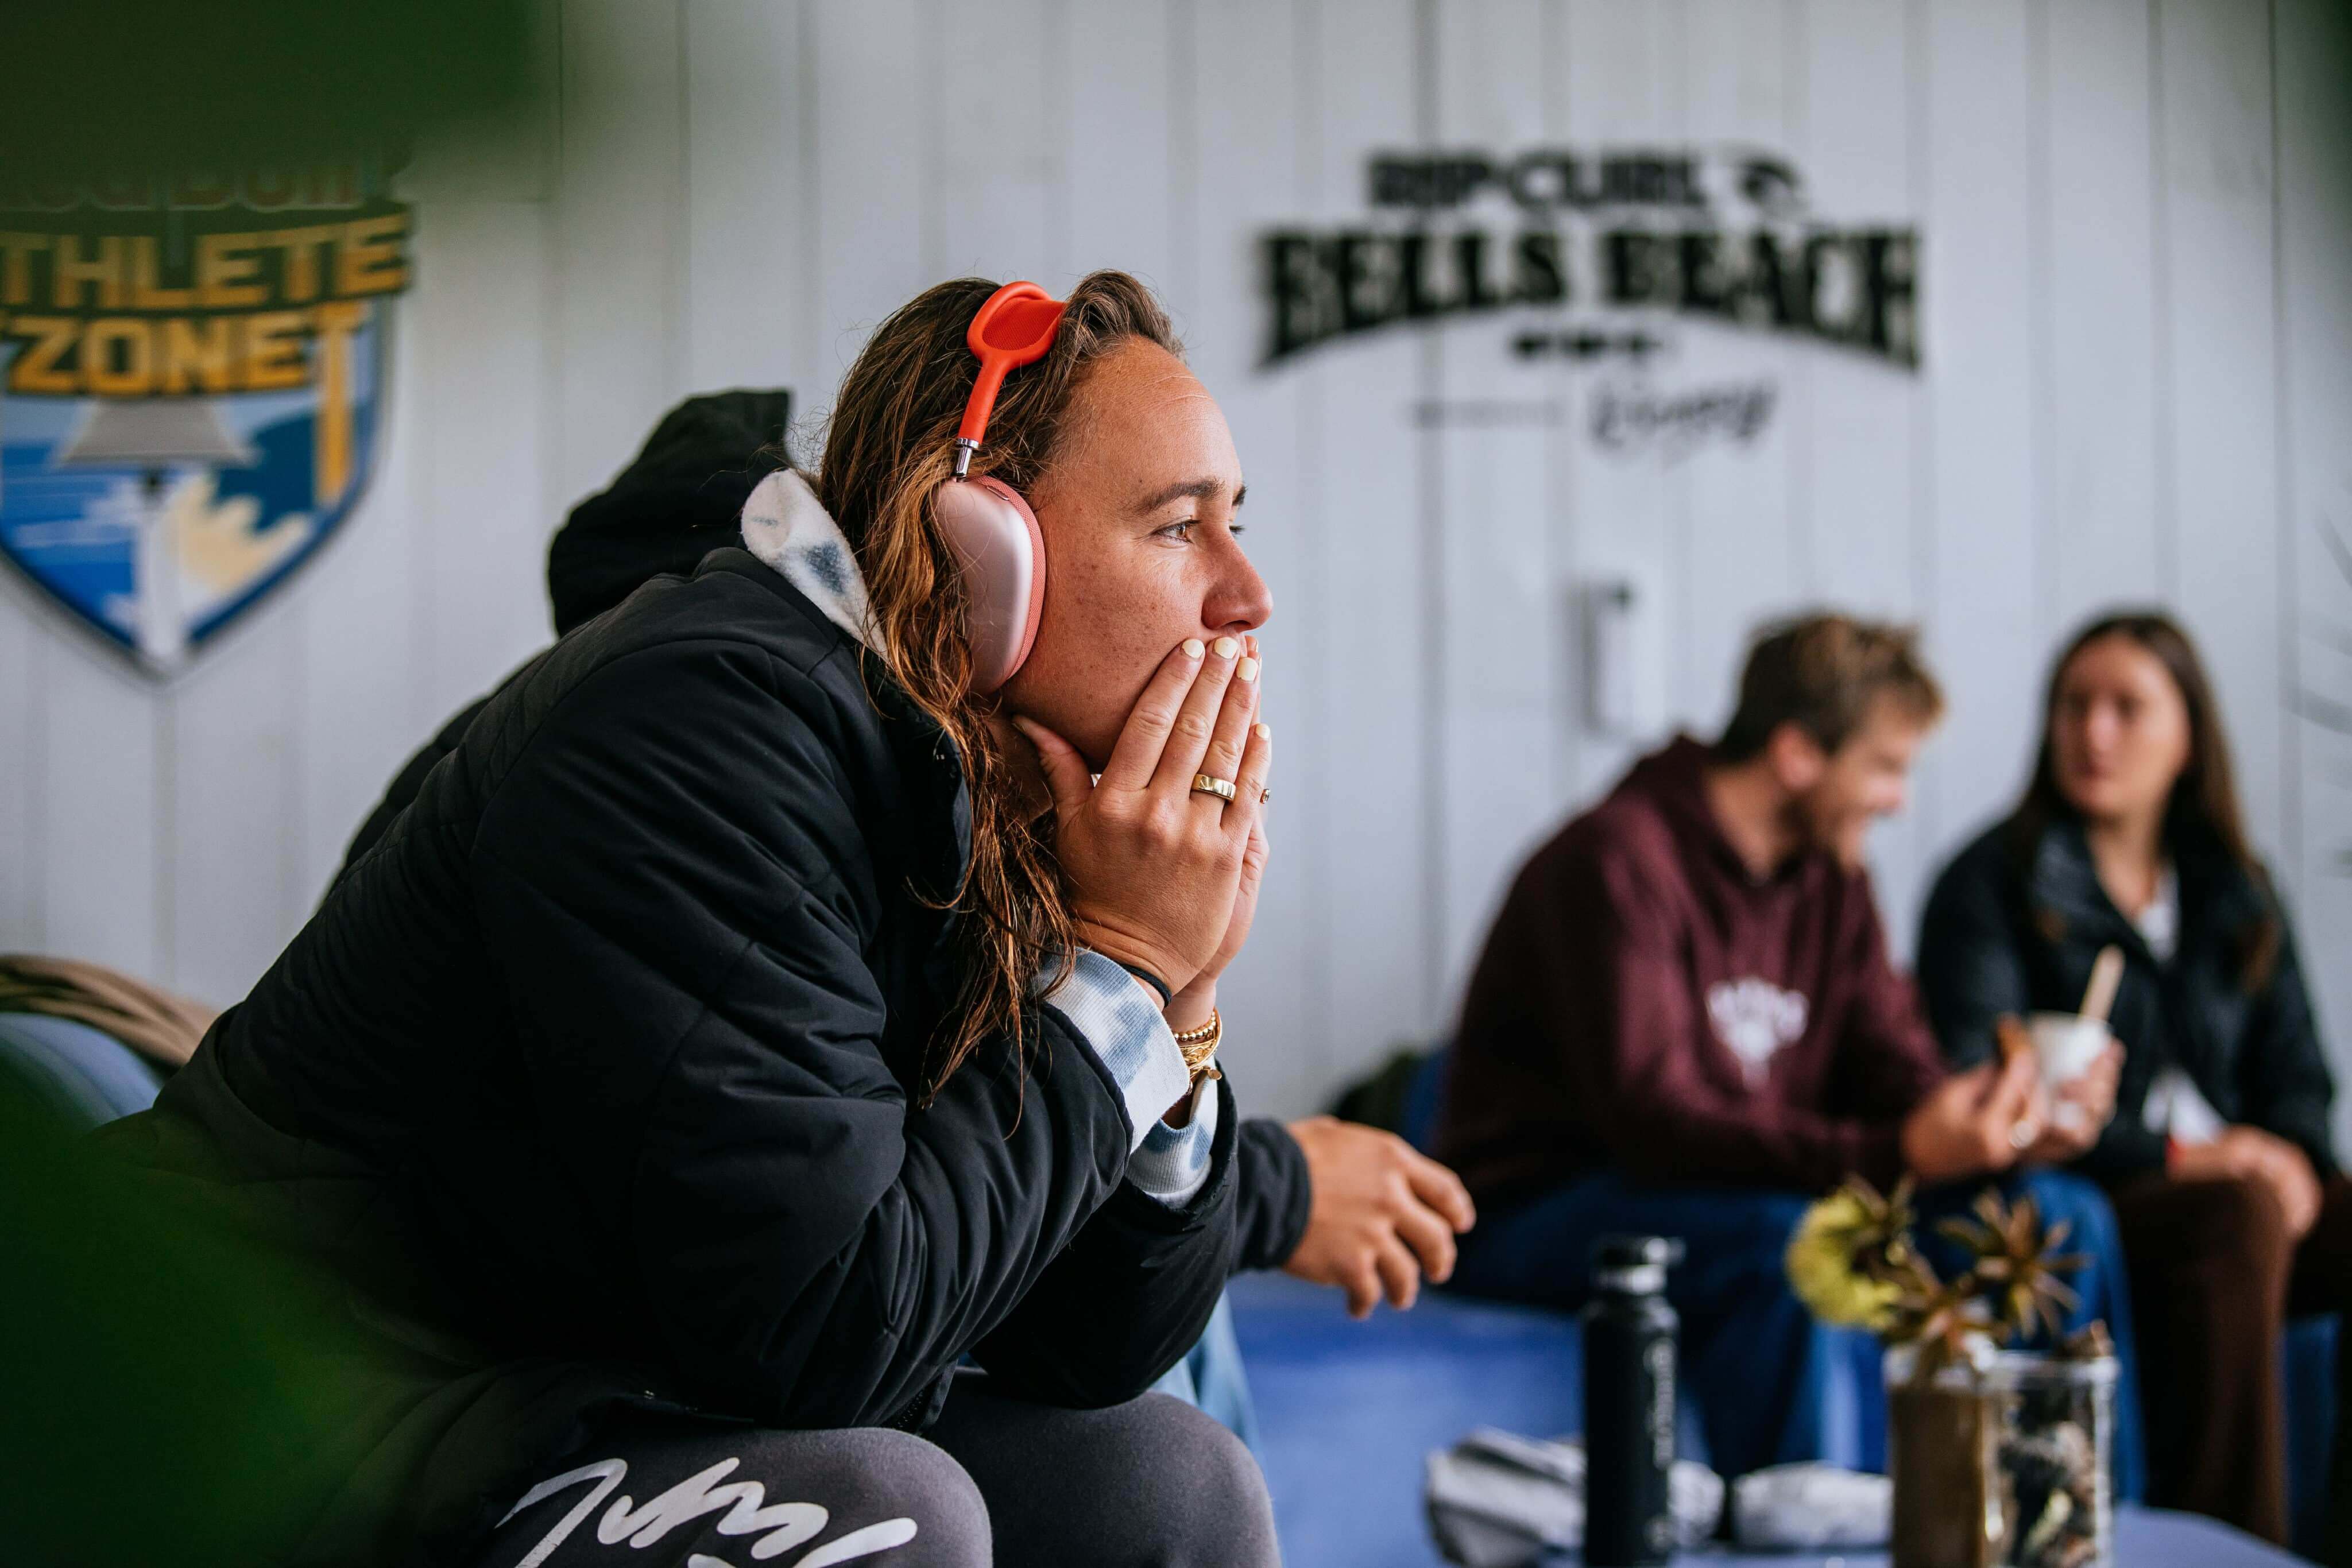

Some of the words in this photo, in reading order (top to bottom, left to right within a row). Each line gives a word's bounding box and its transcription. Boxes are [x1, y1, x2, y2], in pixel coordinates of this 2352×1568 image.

[7, 313, 313, 396] ZONE
[1256, 229, 1564, 370] BELLS
[1597, 229, 1922, 372] BEACH
